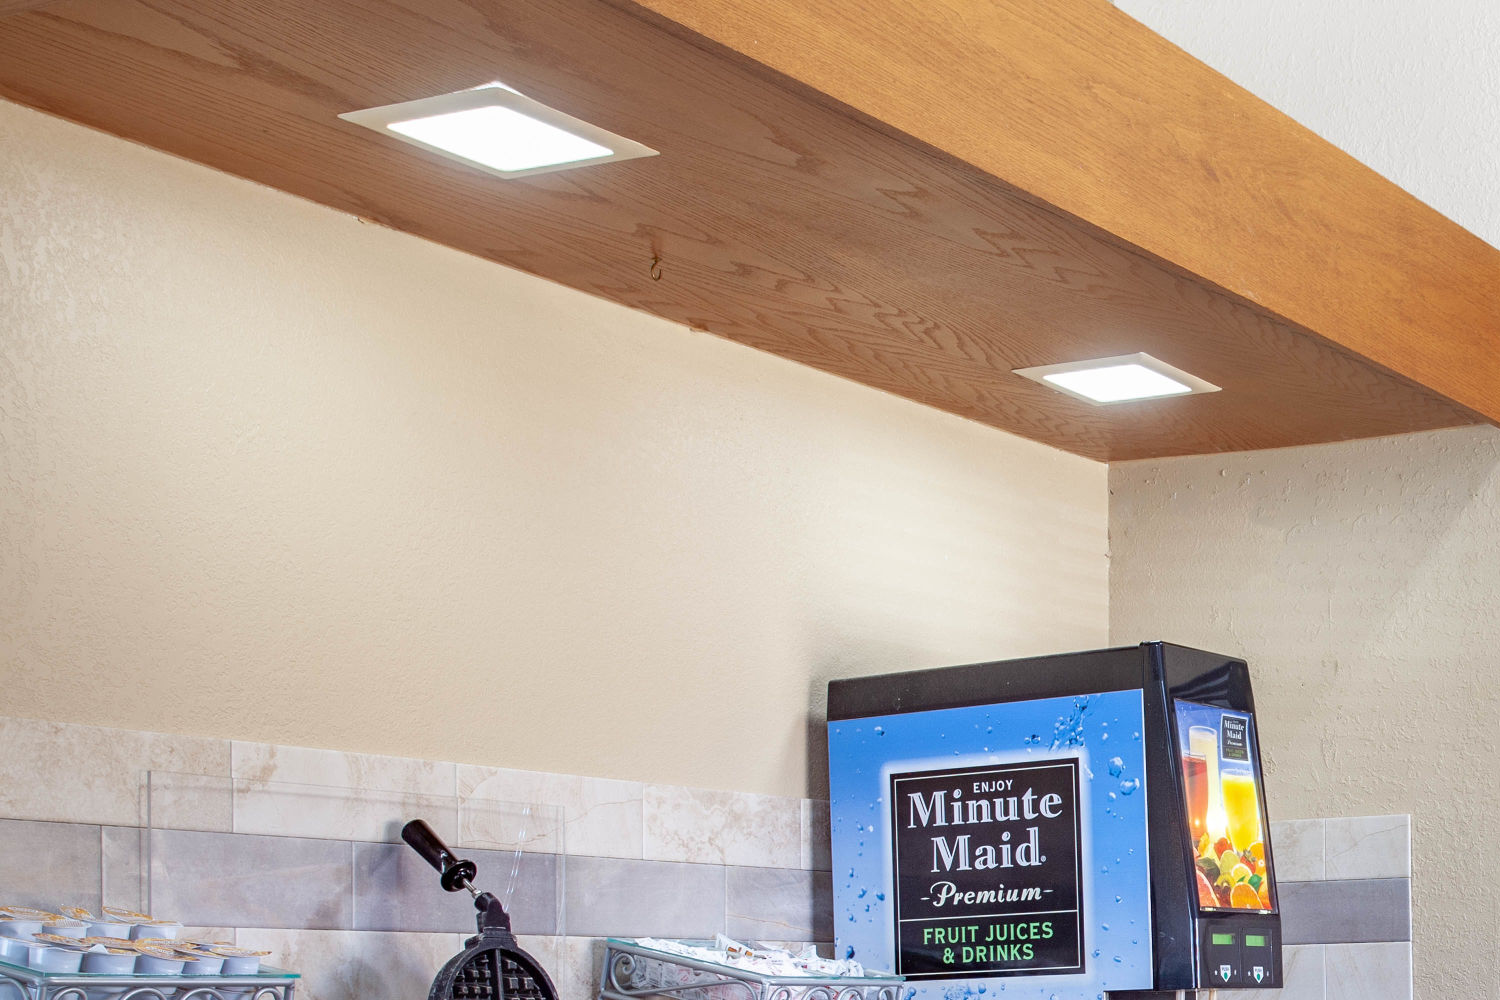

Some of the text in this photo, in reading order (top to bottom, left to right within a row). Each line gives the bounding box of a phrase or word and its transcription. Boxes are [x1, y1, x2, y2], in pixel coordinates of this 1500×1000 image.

[1226, 729, 1242, 740] Maid
[973, 779, 1013, 794] ENJOY
[907, 787, 1063, 828] Minute
[923, 921, 1054, 945] FRUIT JUICES
[942, 943, 1035, 965] & DRINKS
